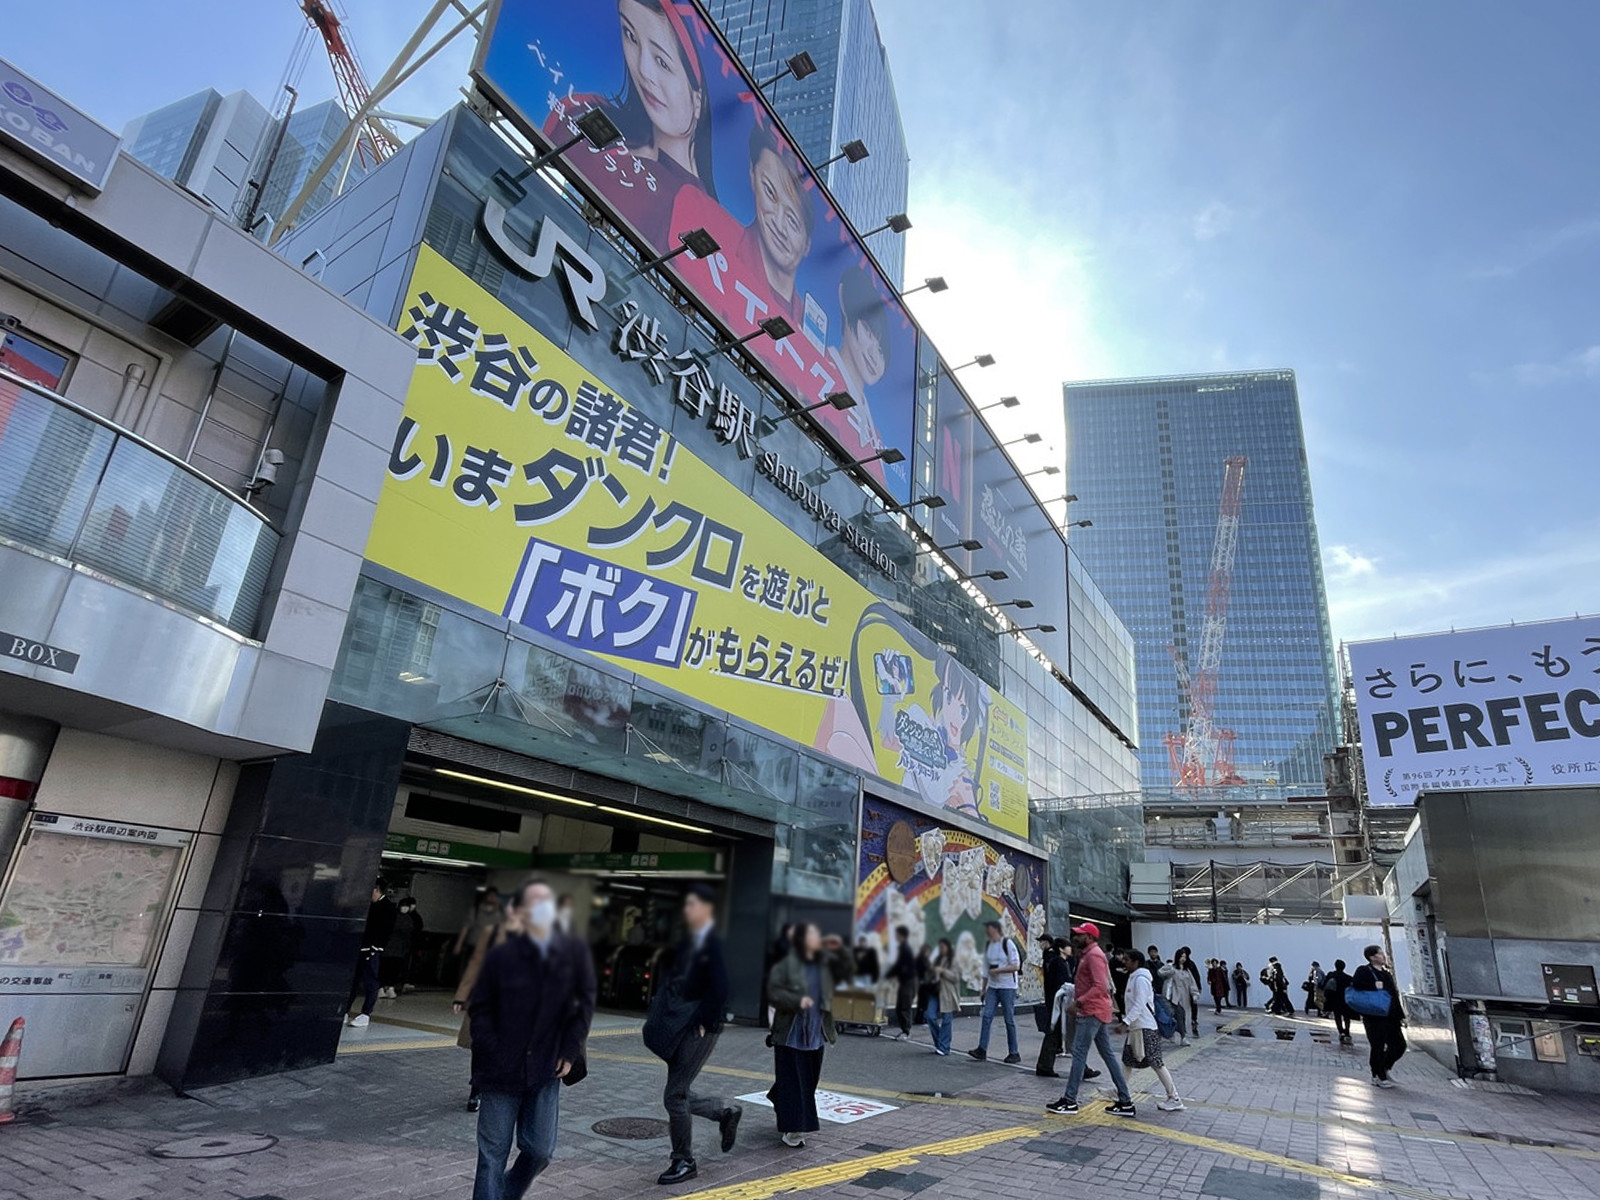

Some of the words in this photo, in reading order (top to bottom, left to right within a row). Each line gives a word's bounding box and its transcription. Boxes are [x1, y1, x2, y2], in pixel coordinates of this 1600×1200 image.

[479, 196, 607, 332] JR
[615, 300, 756, 459] 渋谷駅
[763, 447, 841, 532] shibuya
[845, 522, 898, 580] station
[8, 637, 63, 667] BOX
[71, 821, 159, 840] 渋谷駅周辺案内図
